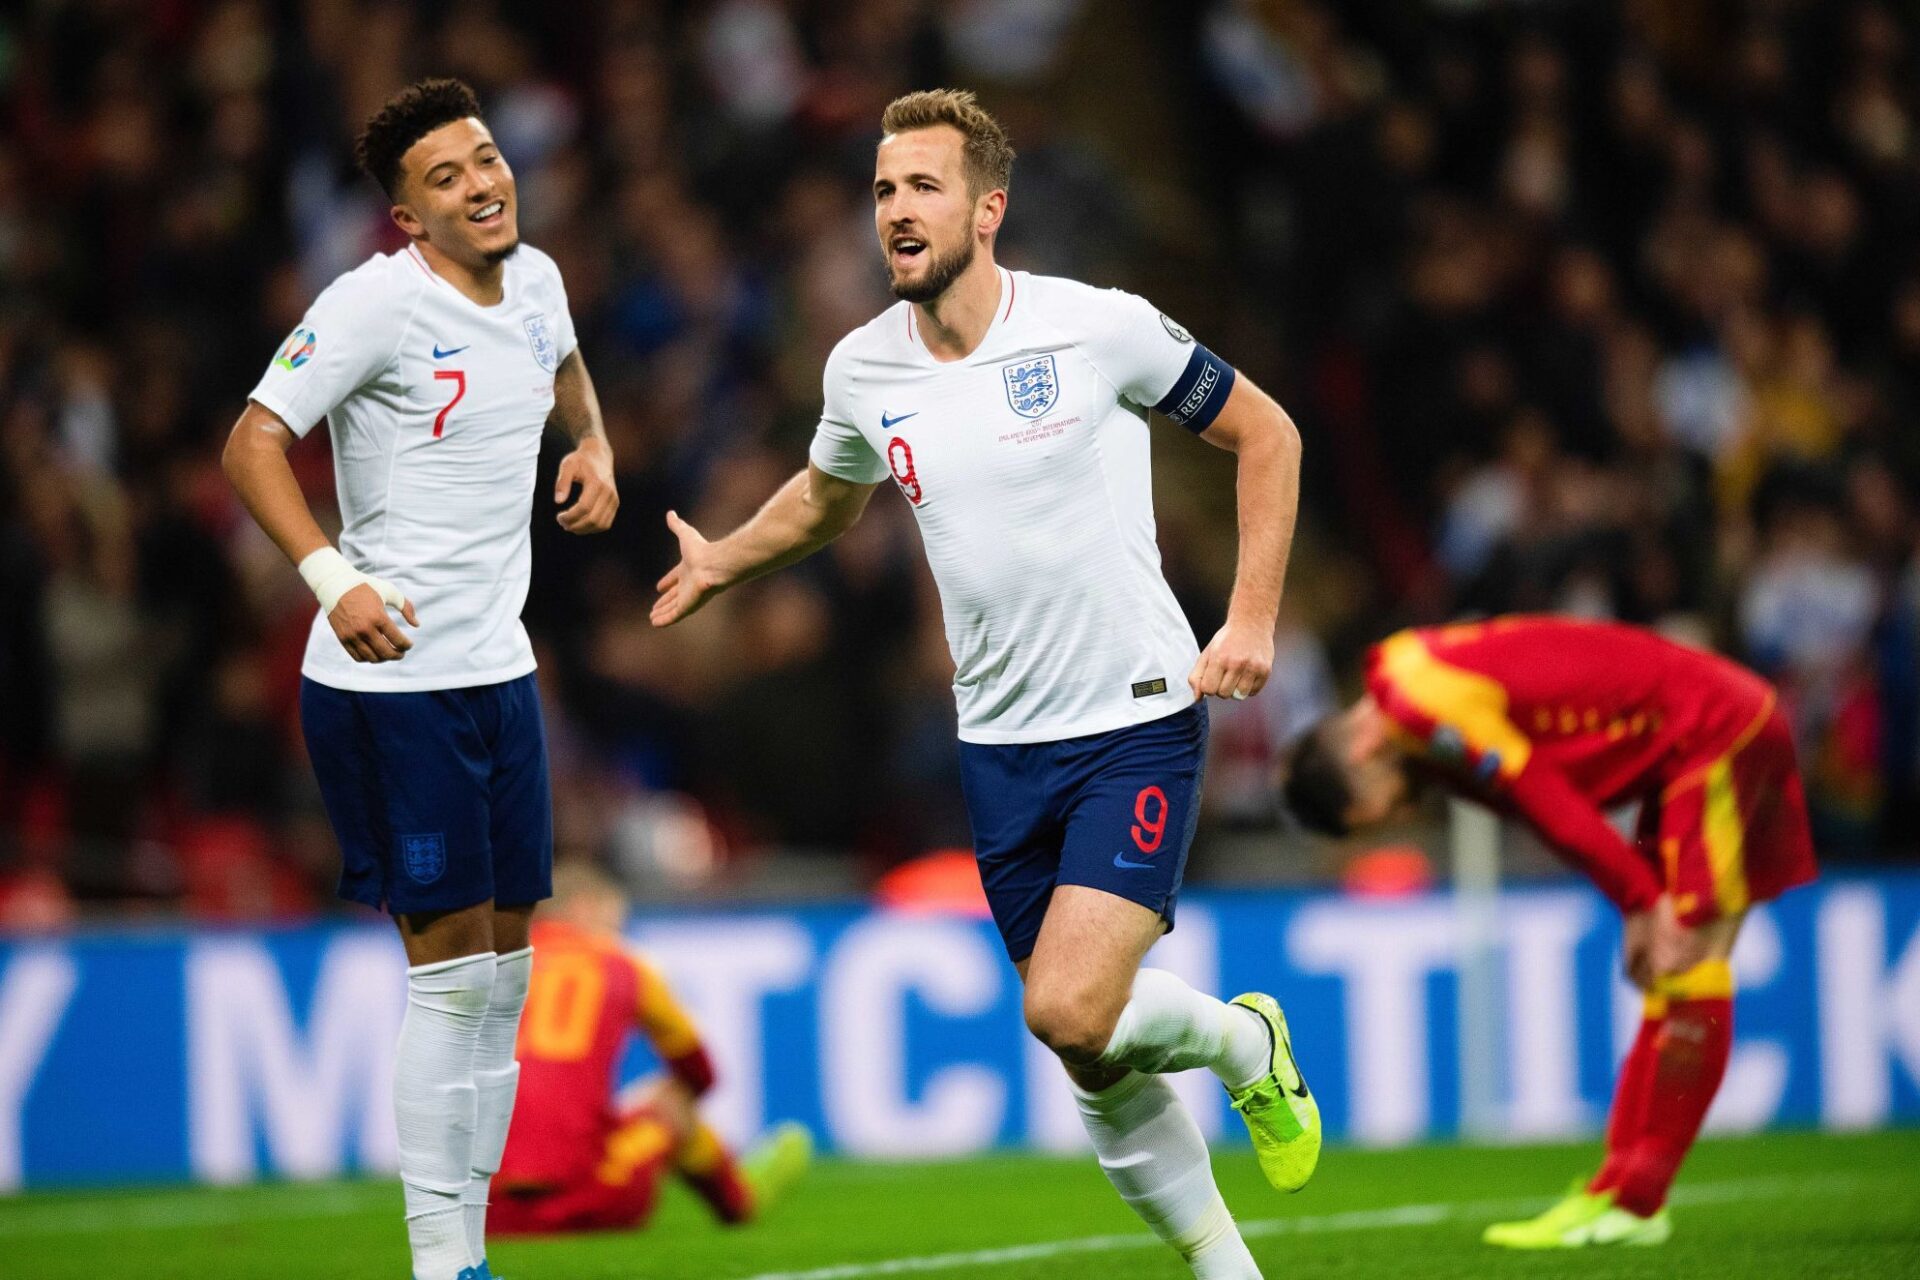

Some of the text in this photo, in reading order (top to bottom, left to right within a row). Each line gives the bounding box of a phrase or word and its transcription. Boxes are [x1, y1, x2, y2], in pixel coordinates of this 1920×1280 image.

[432, 370, 467, 439] 7
[1180, 363, 1218, 416] RESPECT
[887, 436, 923, 506] 9
[1131, 785, 1169, 854] 9
[183, 905, 1222, 1182] MTC
